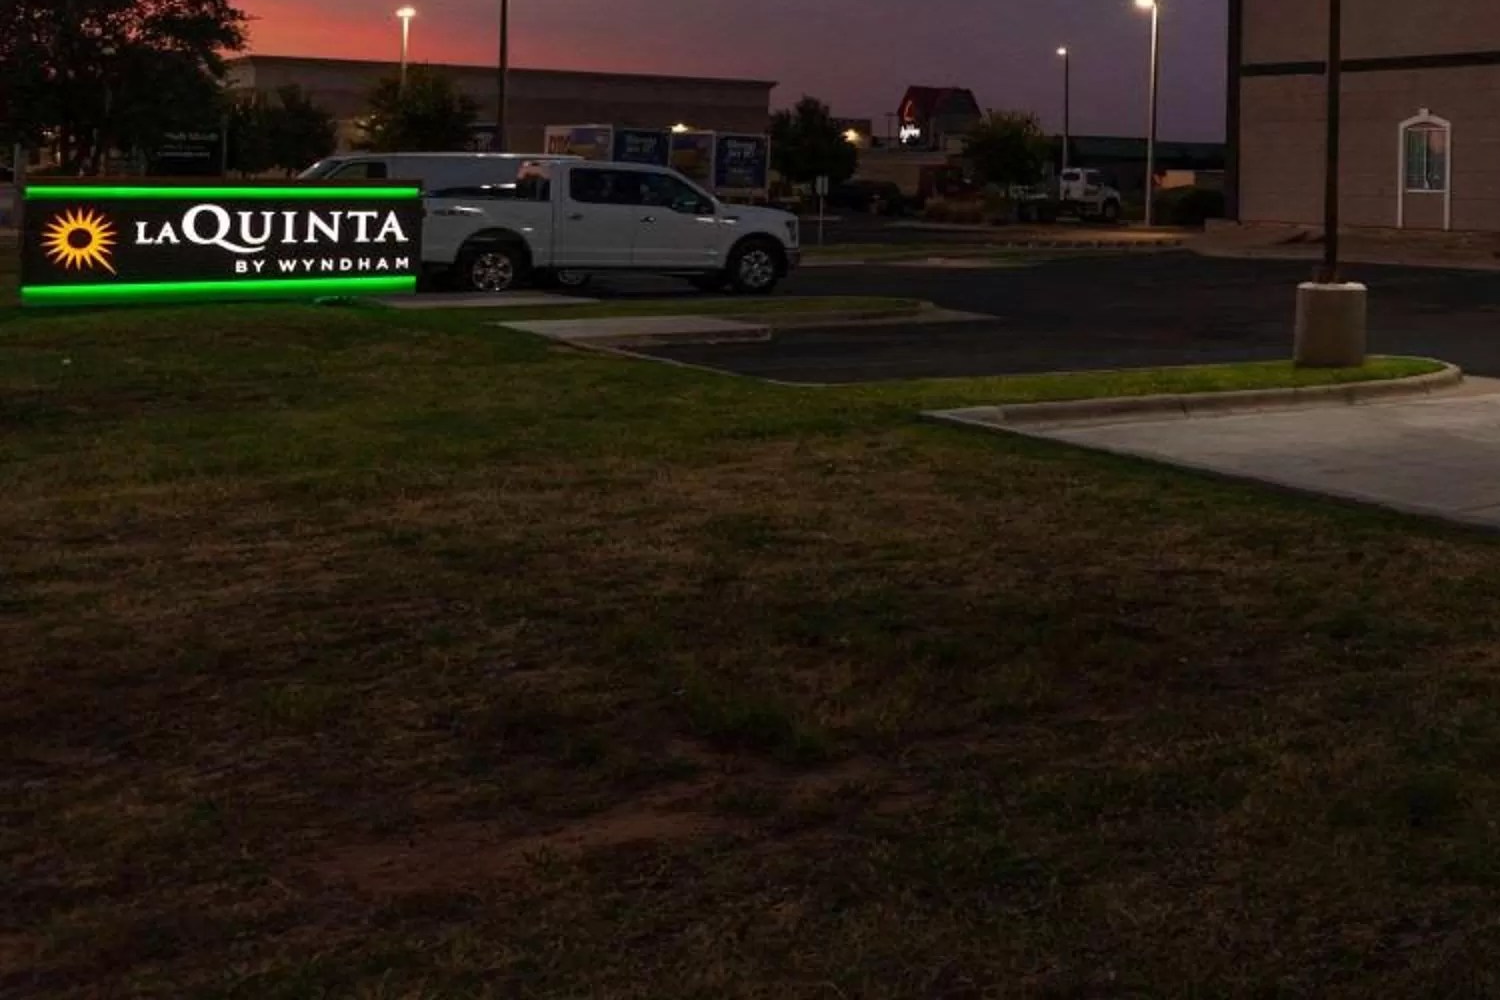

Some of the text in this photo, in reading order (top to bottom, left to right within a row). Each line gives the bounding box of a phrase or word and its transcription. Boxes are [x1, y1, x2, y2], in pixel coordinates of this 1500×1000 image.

[181, 203, 409, 254] QUINTA
[235, 257, 410, 273] BY WYNDHAM
